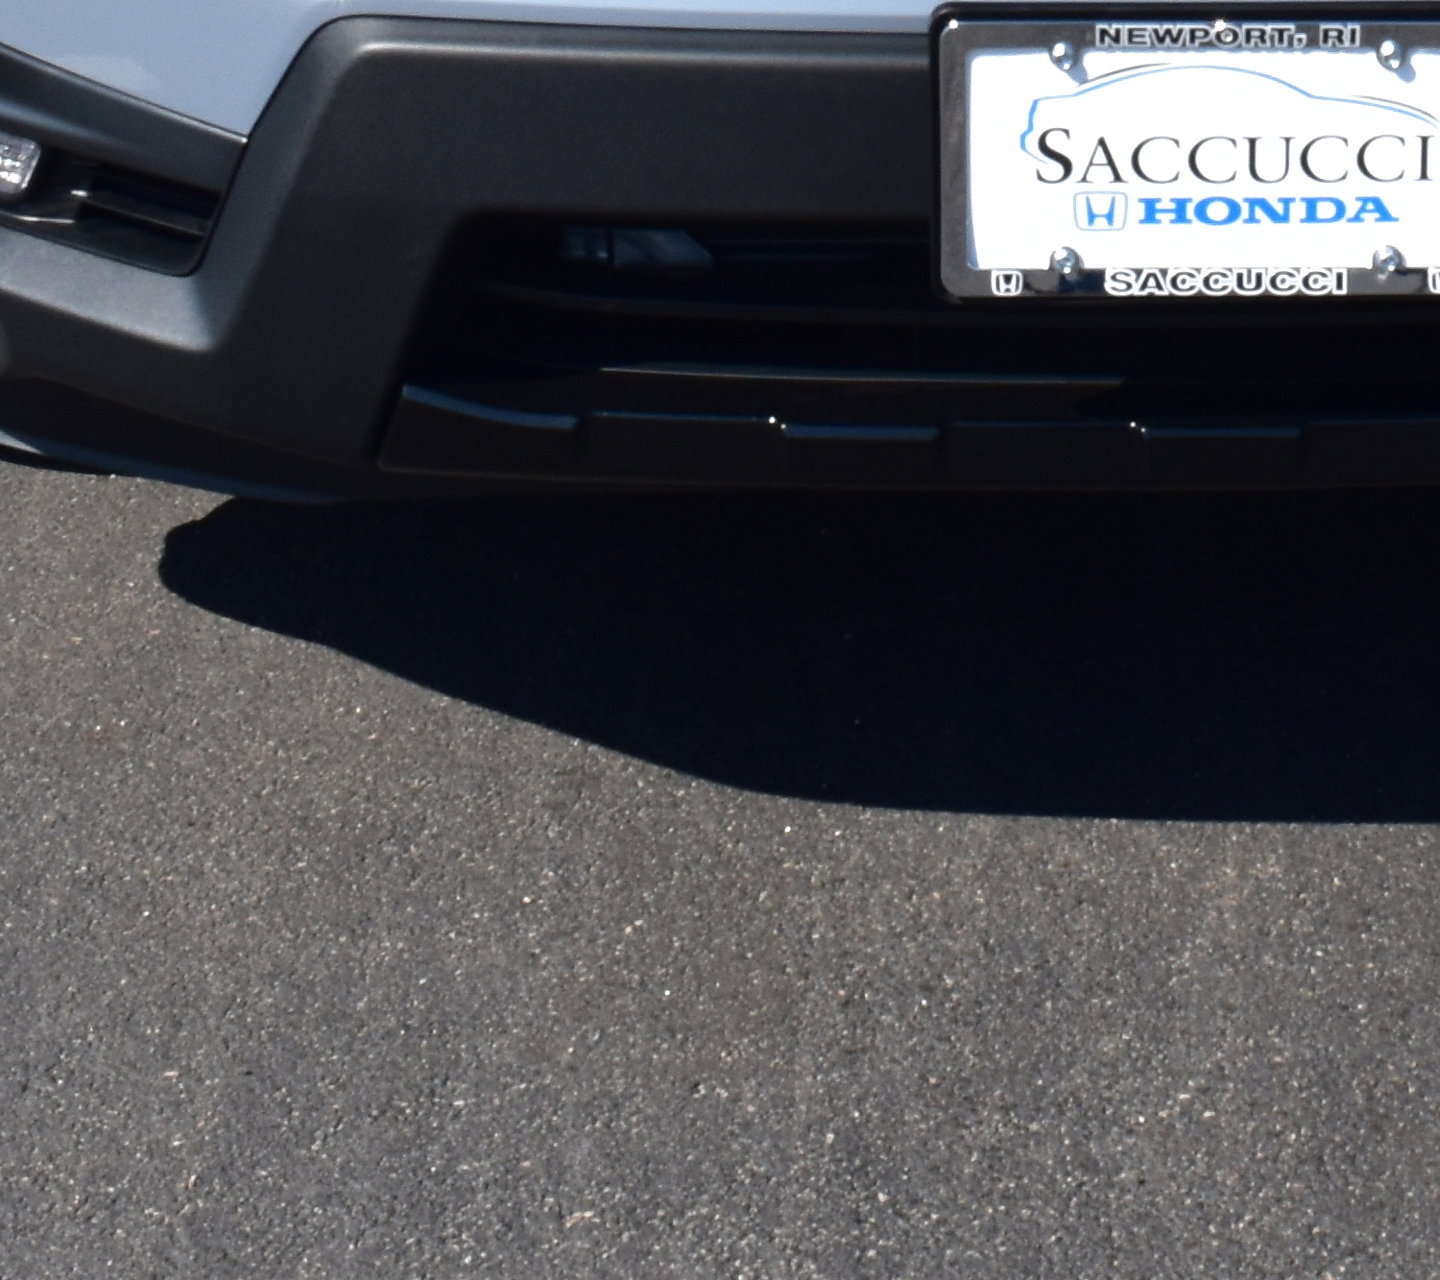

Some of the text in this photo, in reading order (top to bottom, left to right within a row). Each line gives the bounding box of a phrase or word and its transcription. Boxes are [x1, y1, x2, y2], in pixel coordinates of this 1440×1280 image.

[1096, 22, 1361, 50] NEWPORT, RI
[1035, 127, 1435, 185] SACCUCCI
[1137, 197, 1400, 225] HONDA
[1104, 270, 1349, 297] SACCUCCI
